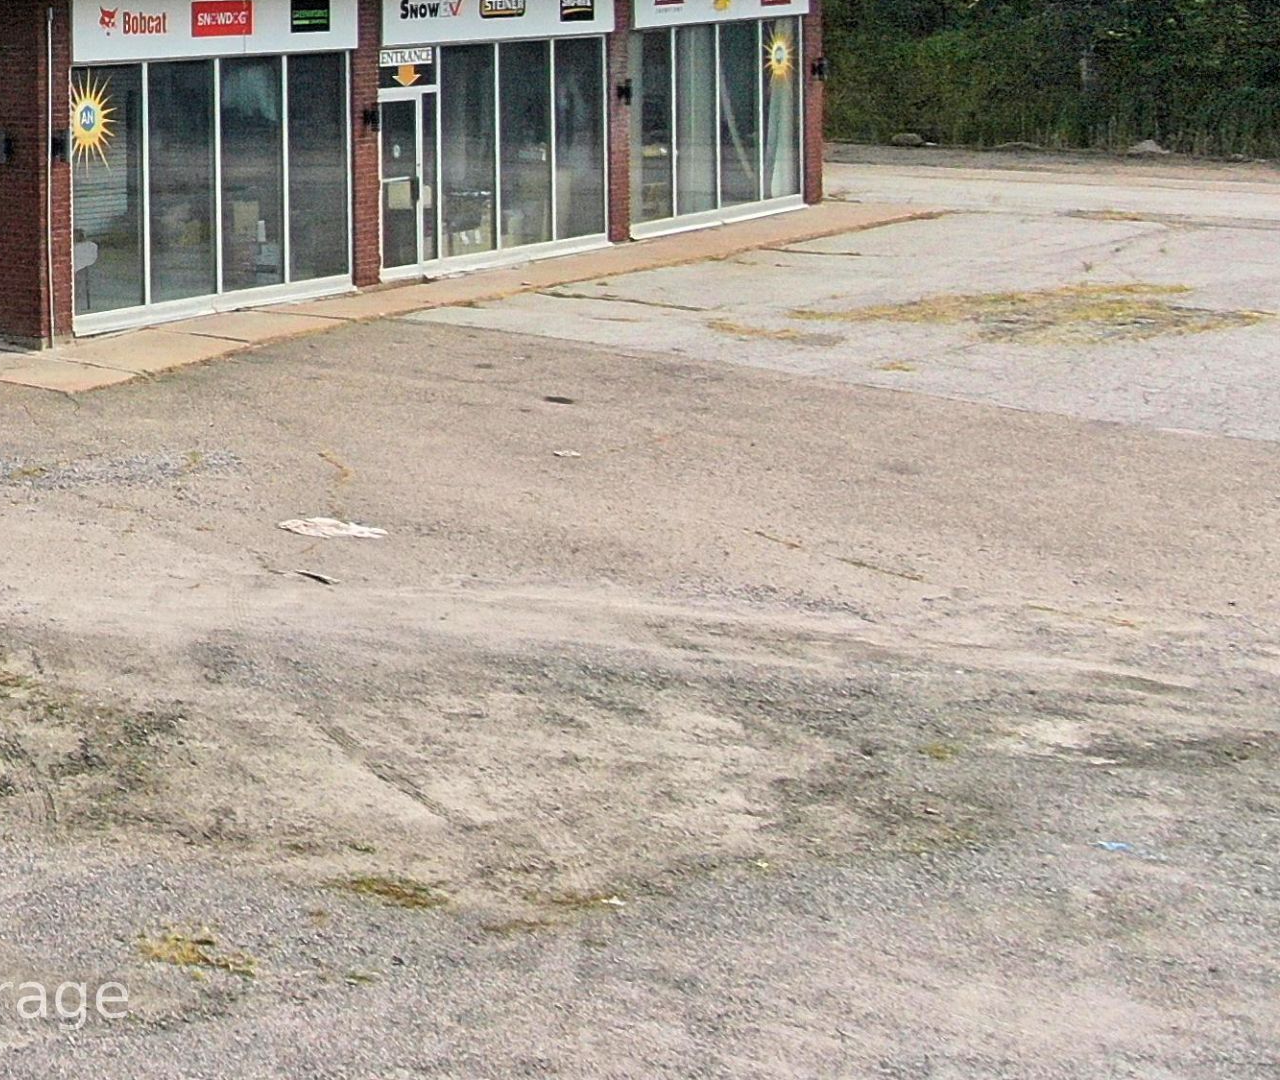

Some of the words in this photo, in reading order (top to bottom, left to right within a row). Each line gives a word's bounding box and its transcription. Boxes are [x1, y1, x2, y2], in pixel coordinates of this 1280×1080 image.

[122, 11, 167, 35] Bobcat
[197, 11, 247, 26] SNOWDOG
[381, 48, 432, 64] ENTRANCE
